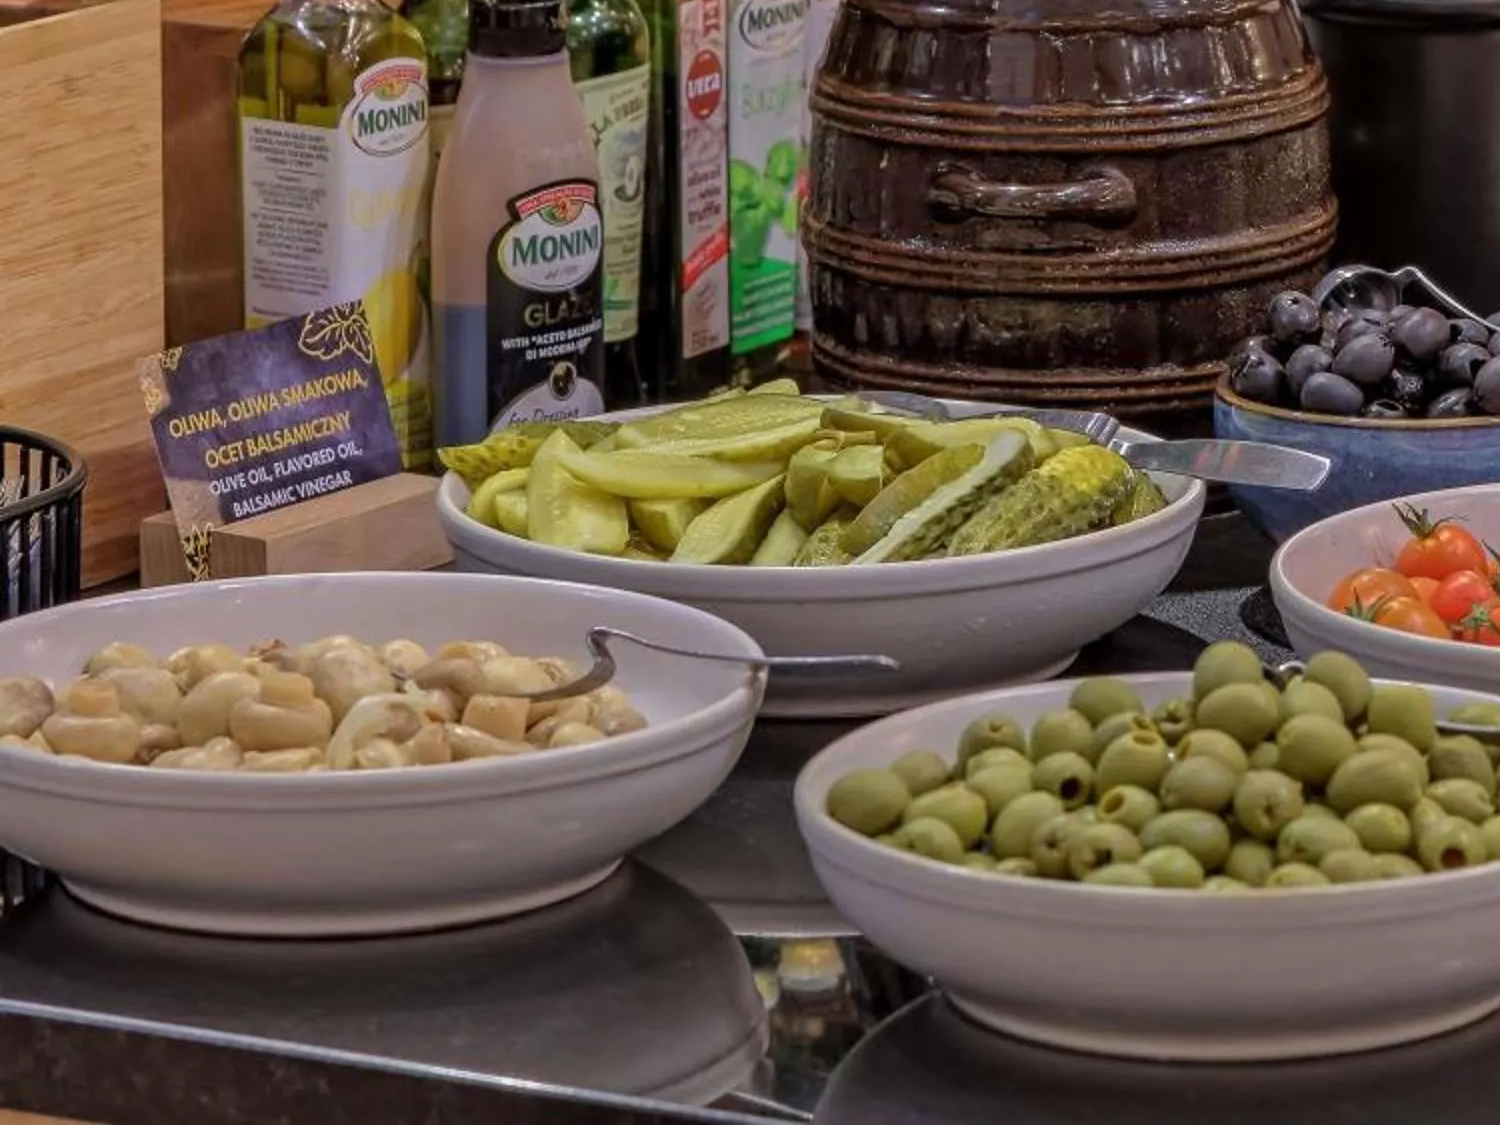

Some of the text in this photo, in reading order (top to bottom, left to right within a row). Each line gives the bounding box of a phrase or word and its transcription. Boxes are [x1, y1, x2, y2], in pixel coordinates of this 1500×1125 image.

[358, 99, 426, 138] MONINI
[512, 224, 598, 267] MONINI
[168, 367, 370, 439] OLIWA, OLIWA SMAKOWA,
[205, 410, 352, 470] OCET BALSAMICZNY
[209, 475, 248, 497] OLIVE
[247, 465, 273, 487] OIL,
[273, 447, 336, 479] FLAVORED
[232, 469, 353, 518] BALSAMIC VINEGAR
